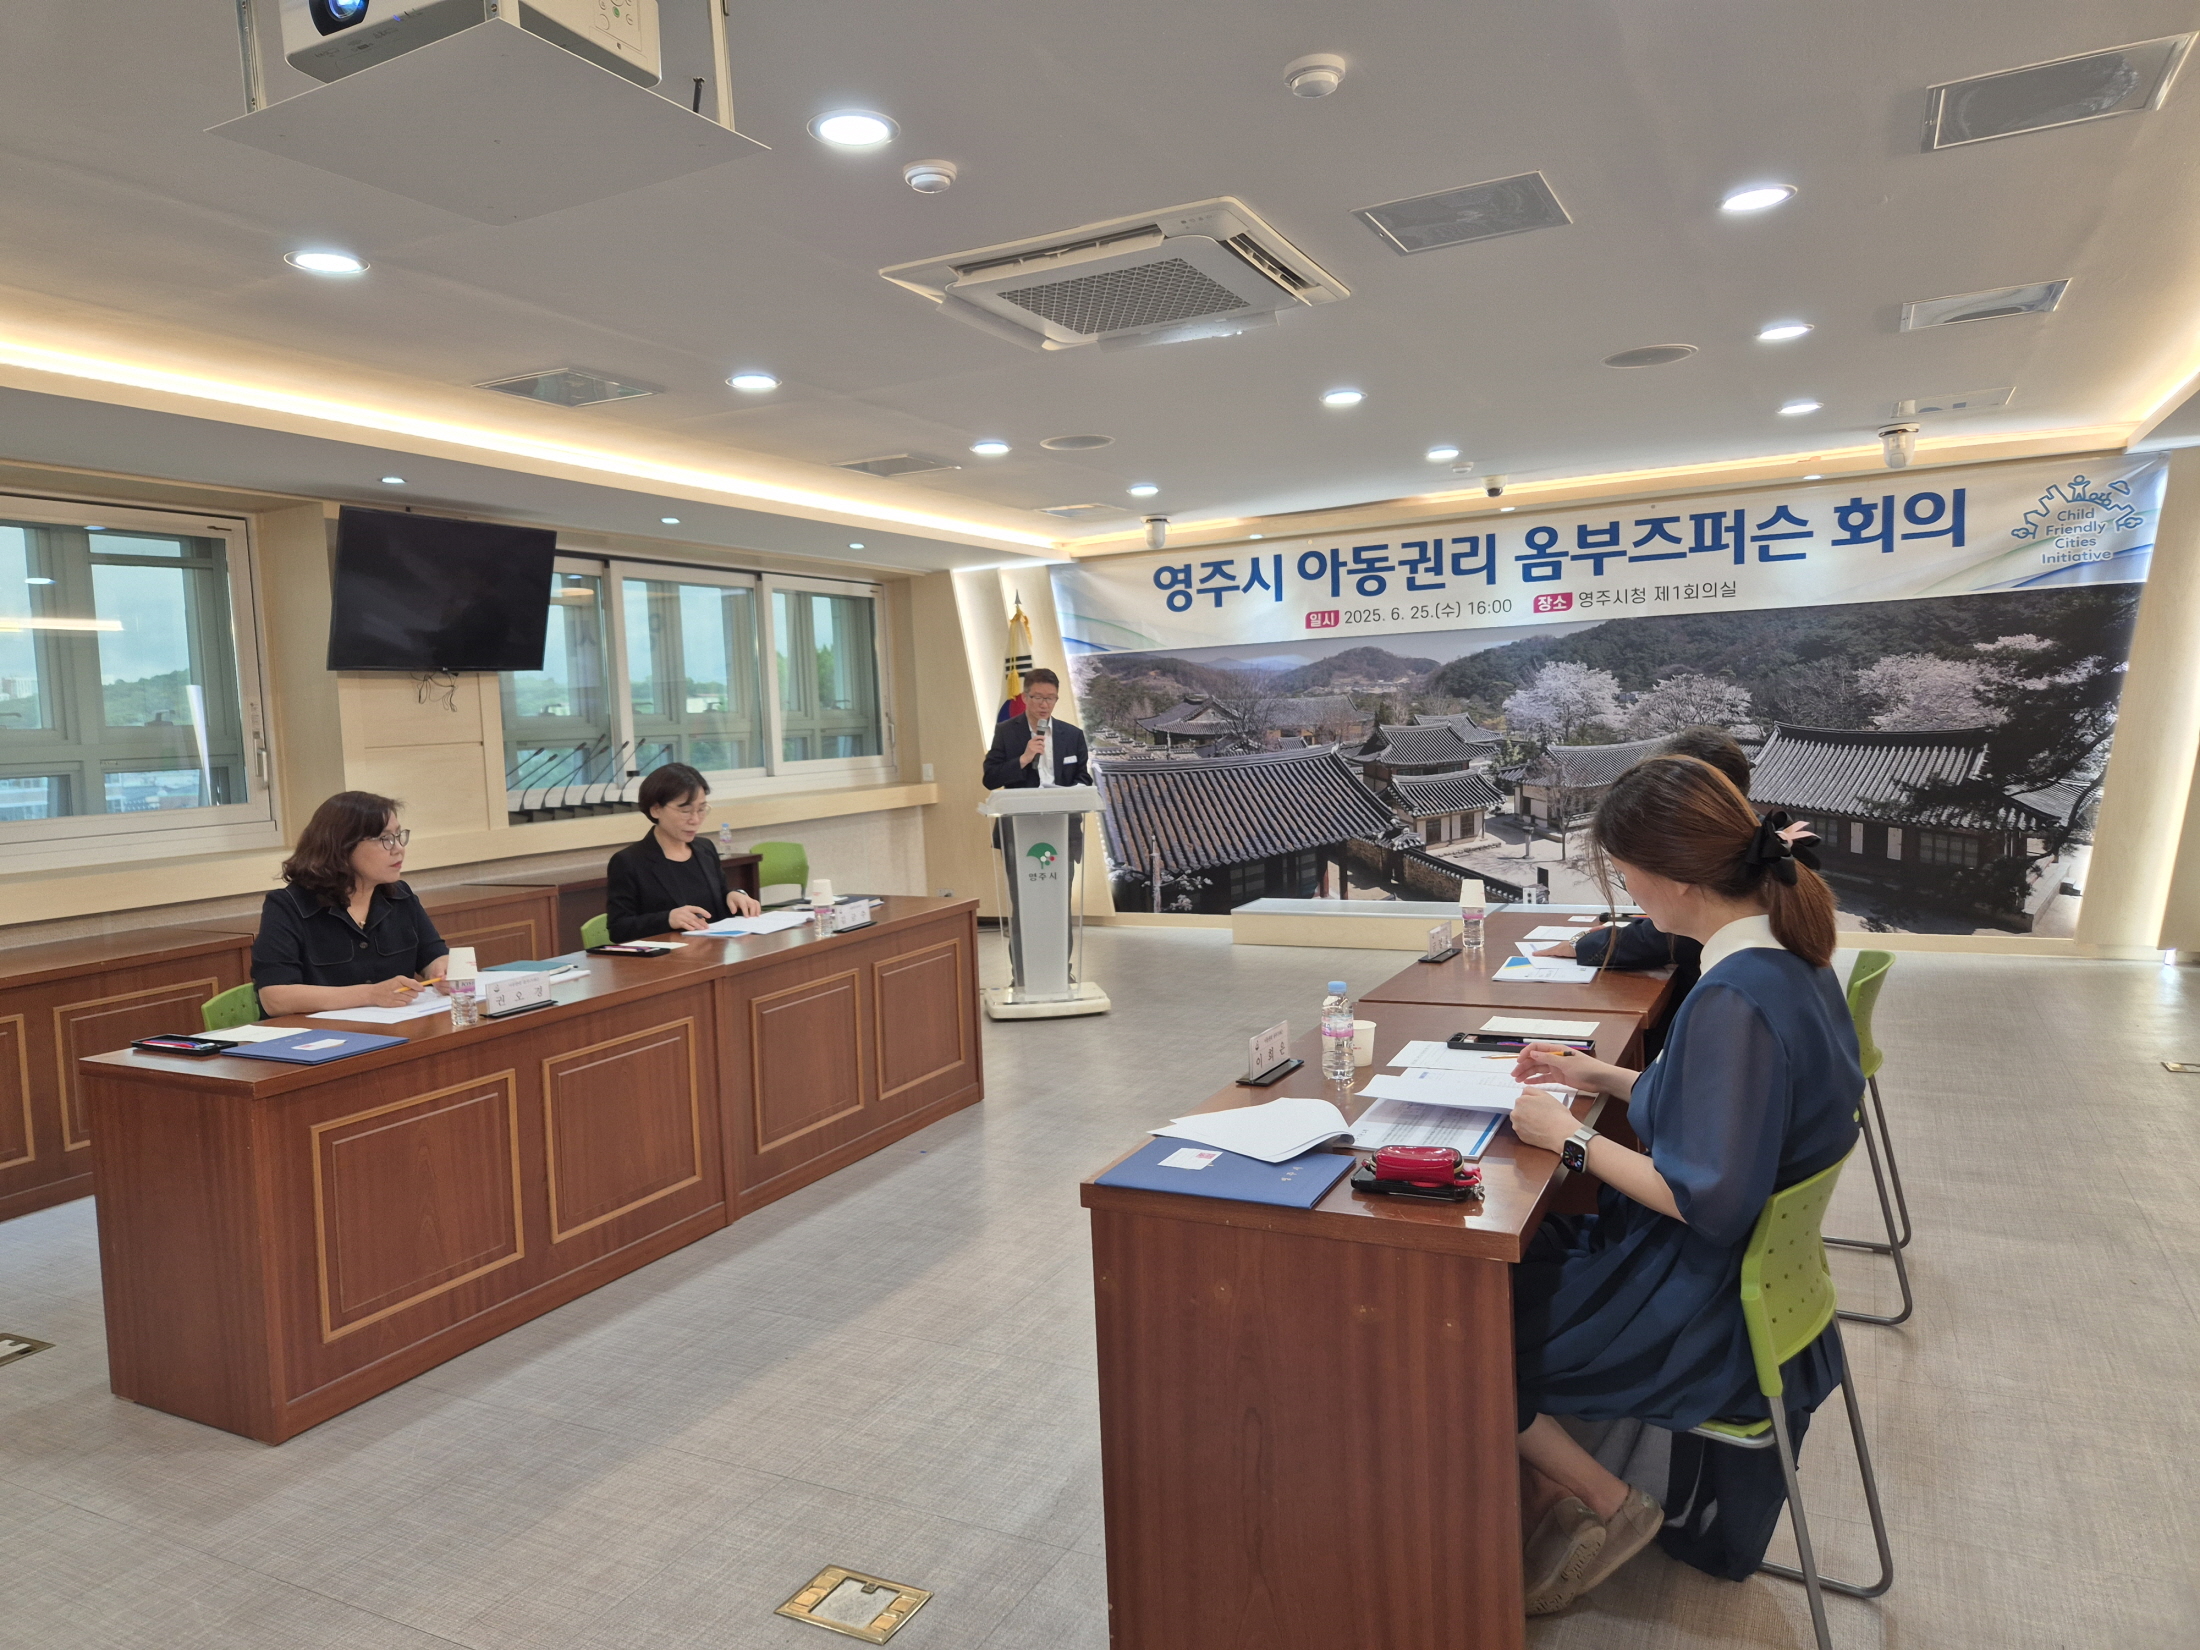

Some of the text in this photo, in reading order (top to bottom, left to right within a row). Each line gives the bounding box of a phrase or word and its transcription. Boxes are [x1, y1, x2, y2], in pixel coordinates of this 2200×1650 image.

[2057, 507, 2095, 521] Child
[2045, 521, 2106, 536] Friendly
[1153, 488, 1966, 613] 영주시 아동권리 옴부즈퍼슨 회의
[2055, 537, 2096, 549] Cities
[2042, 549, 2111, 564] Initiative
[1309, 580, 1737, 628] 일시 2025. 6. 25.(수) 16:00 장소 영주시청 제1회의실
[1028, 872, 1057, 881] 영주시
